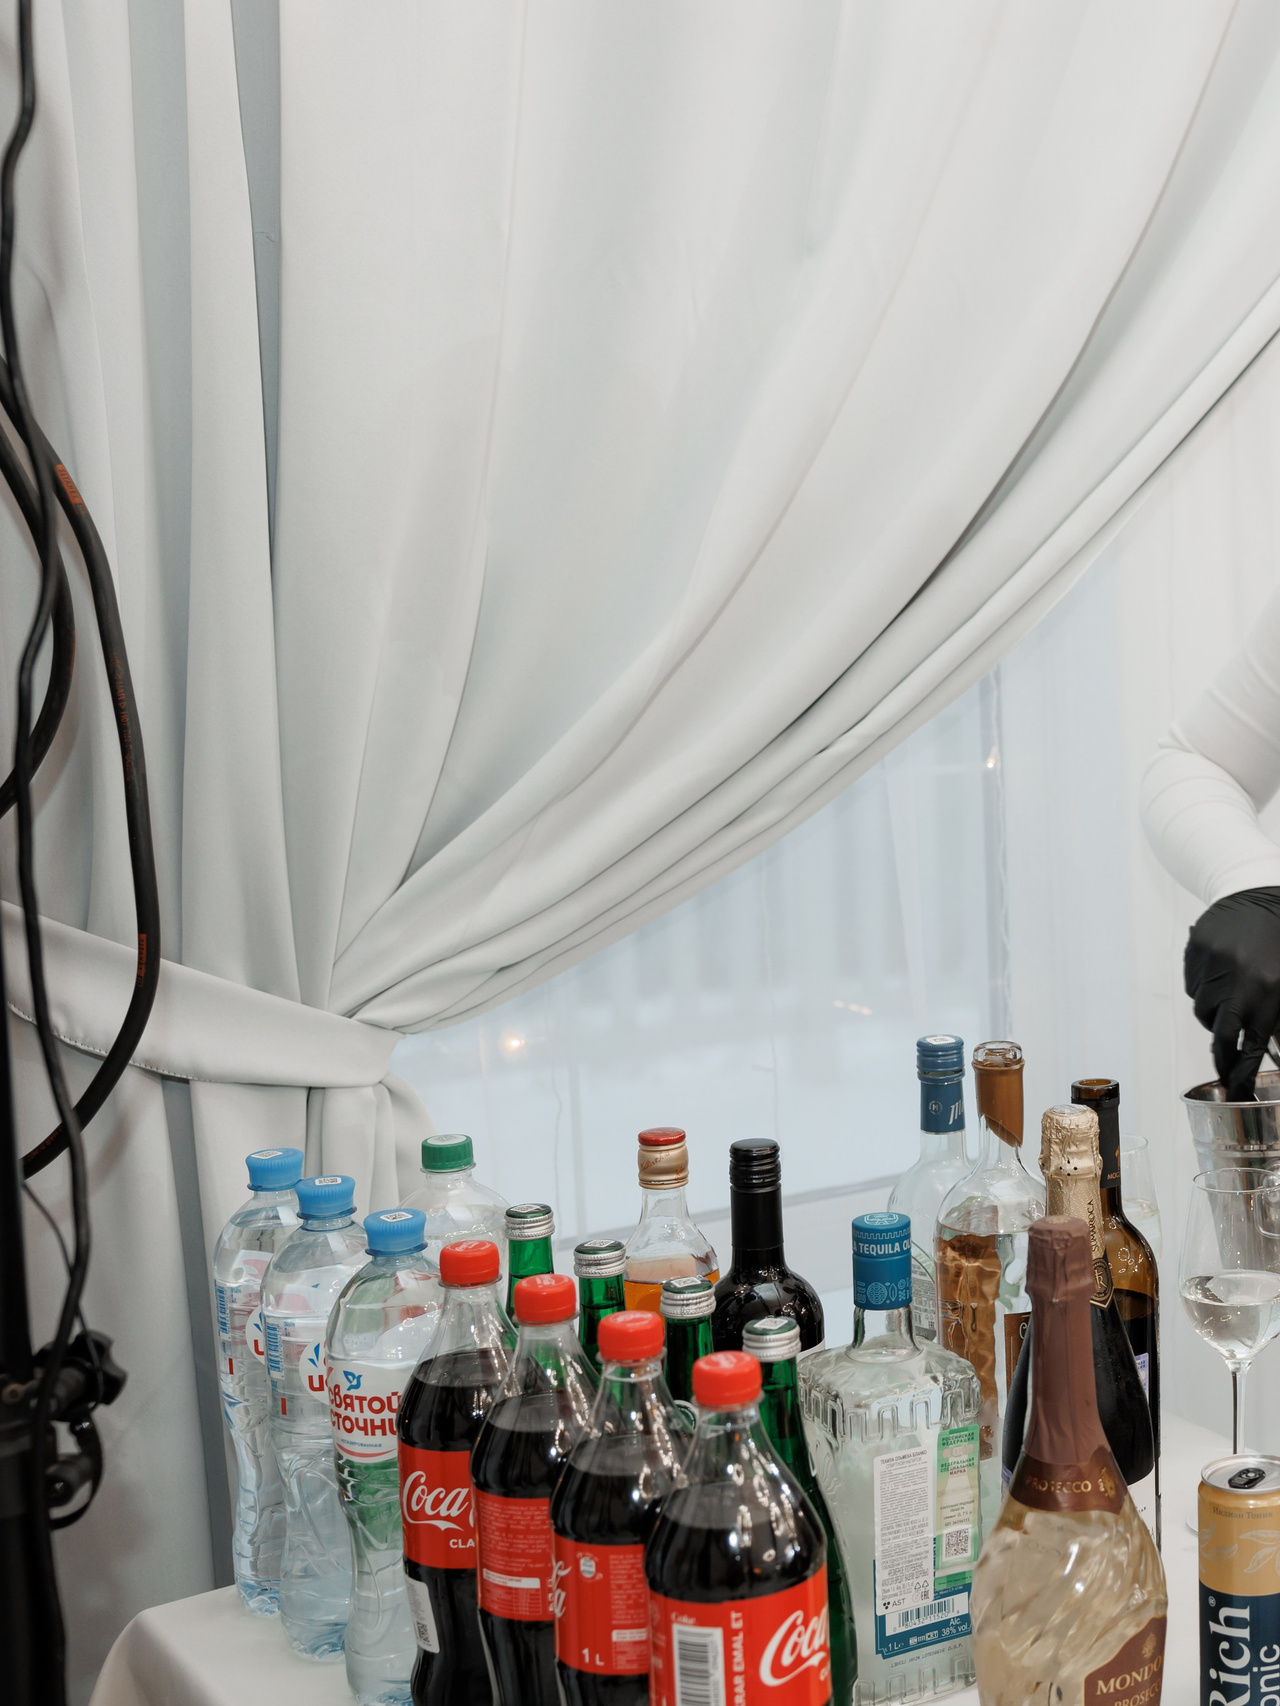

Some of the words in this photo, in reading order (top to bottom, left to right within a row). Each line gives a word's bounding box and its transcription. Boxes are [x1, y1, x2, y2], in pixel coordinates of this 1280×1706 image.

[859, 1242, 900, 1255] TEQUILA
[1026, 1476, 1092, 1493] PROSECCO
[1213, 1506, 1244, 1519] Индиан
[1246, 1511, 1273, 1519] Тоник
[892, 1598, 906, 1607] AST
[730, 1610, 743, 1629] ET
[941, 1625, 957, 1637] 38%
[582, 1647, 590, 1664] 1
[595, 1653, 605, 1667] L
[732, 1631, 745, 1673] EMAL
[1096, 1655, 1162, 1695] MONDO
[733, 1674, 746, 1706] RAR
